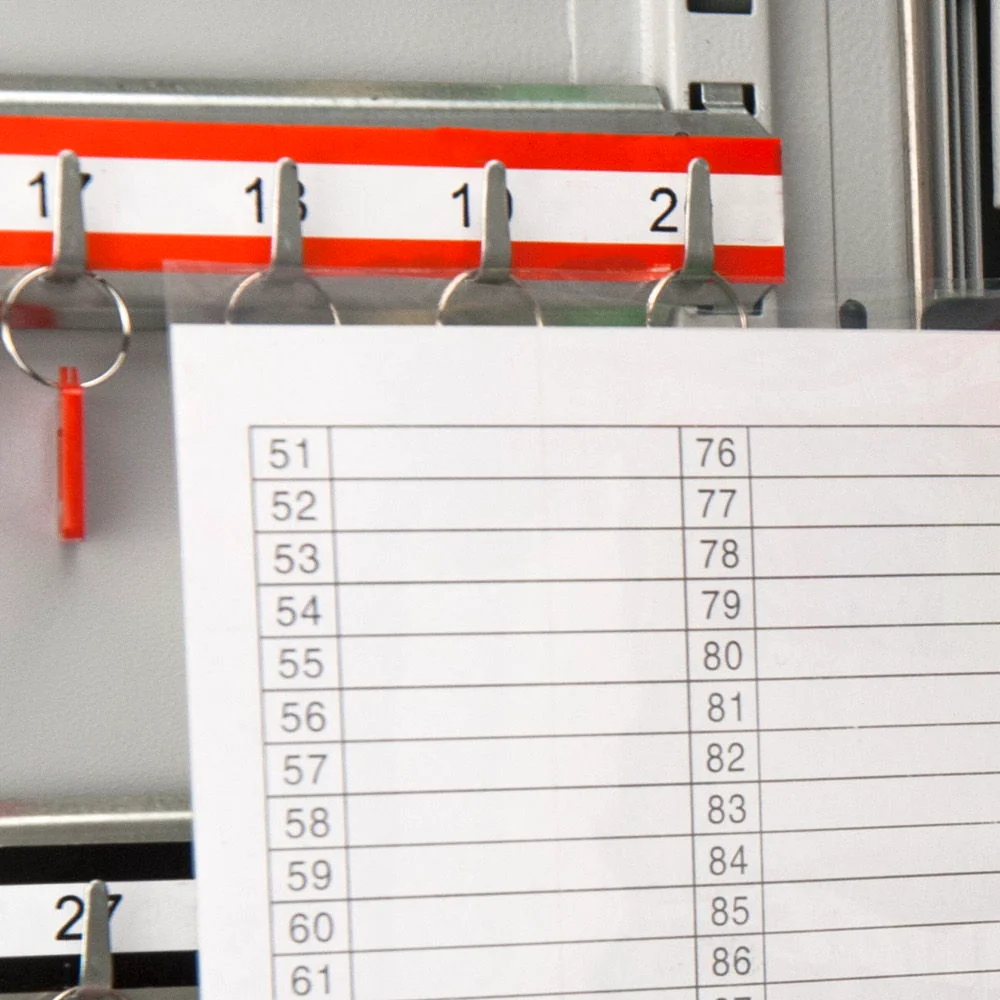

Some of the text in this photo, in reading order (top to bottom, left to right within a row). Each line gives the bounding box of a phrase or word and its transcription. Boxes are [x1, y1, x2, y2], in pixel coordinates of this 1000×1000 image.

[452, 183, 513, 228] 1
[271, 440, 307, 469] 51
[696, 438, 736, 467] 76
[273, 490, 316, 521] 52
[698, 489, 736, 517] 77
[276, 543, 319, 574] 53
[700, 539, 739, 568] 78
[278, 596, 321, 626] 54
[702, 590, 740, 619] 79
[280, 648, 323, 678] 55
[704, 640, 742, 671] 80
[283, 702, 325, 732] 56
[708, 693, 741, 722] 81
[285, 754, 327, 785] 57
[707, 743, 744, 773] 82
[287, 807, 329, 838] 58
[708, 794, 746, 824] 83
[710, 845, 748, 875] 84
[289, 860, 331, 891] 59
[712, 896, 749, 926] 85
[290, 912, 333, 943] 60
[713, 946, 751, 976] 86
[292, 966, 329, 995] 61
